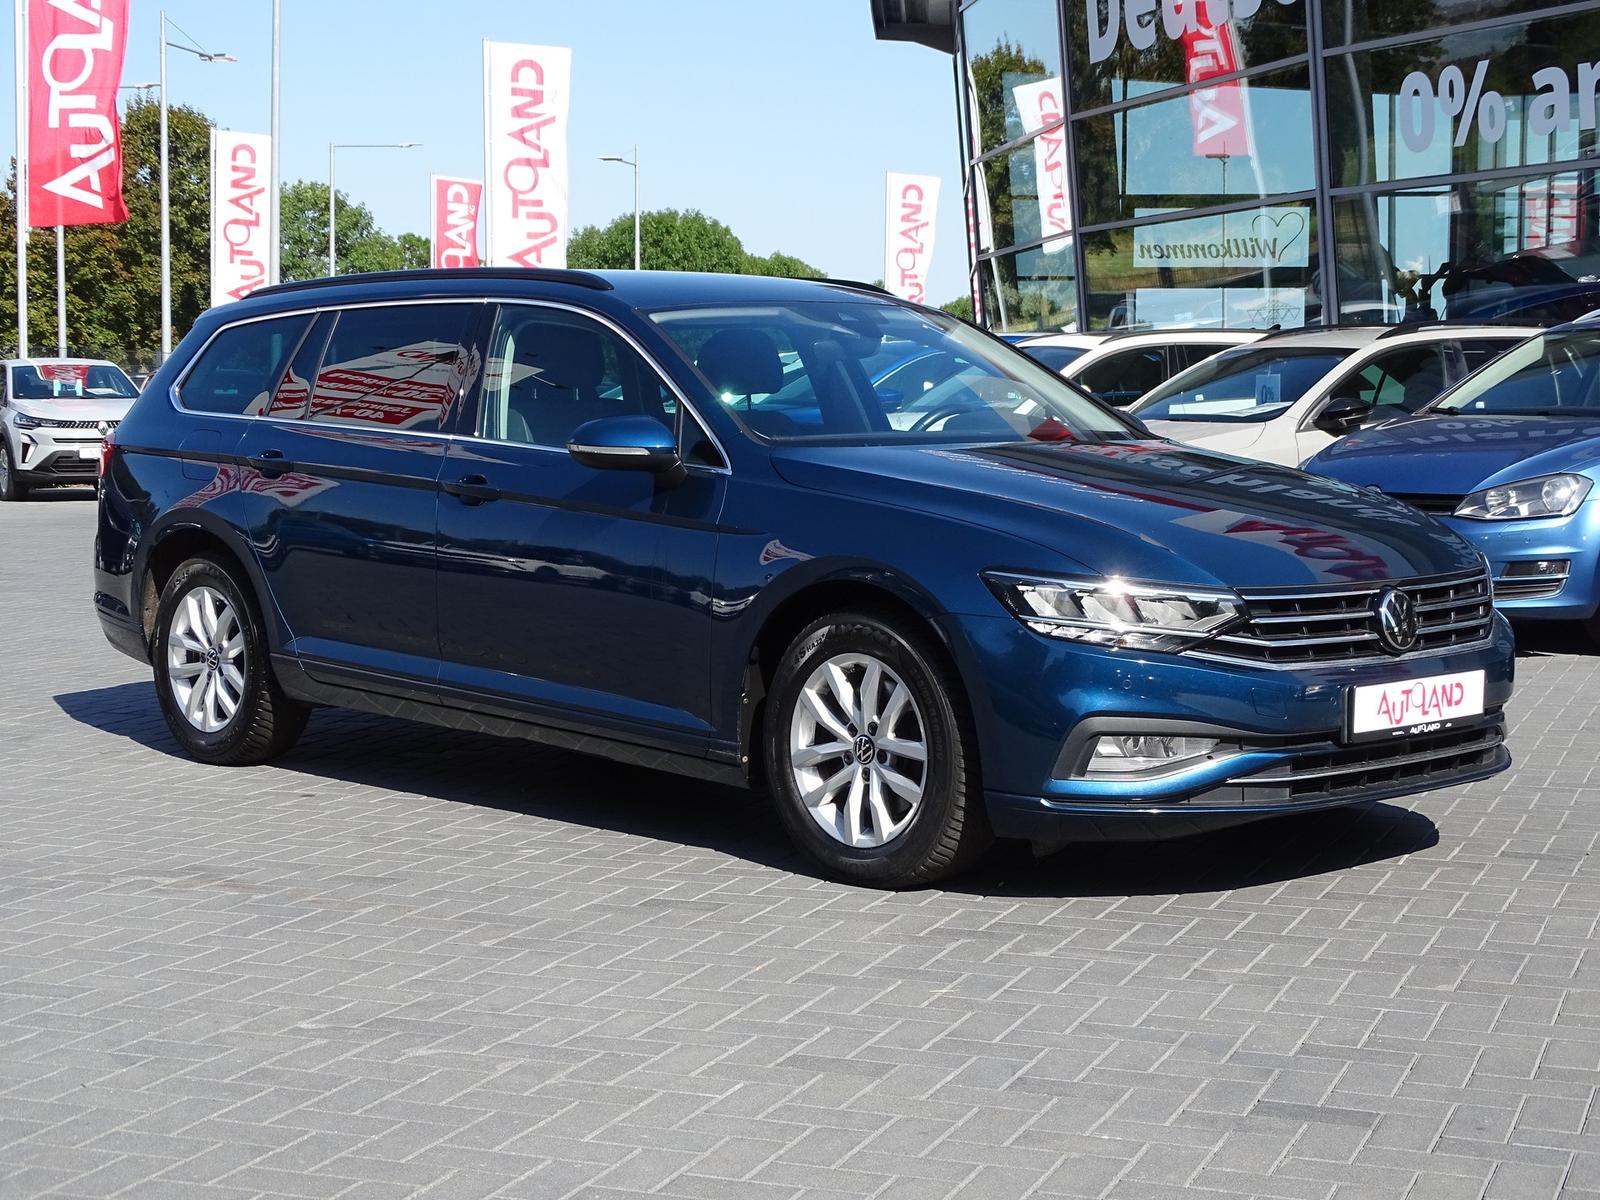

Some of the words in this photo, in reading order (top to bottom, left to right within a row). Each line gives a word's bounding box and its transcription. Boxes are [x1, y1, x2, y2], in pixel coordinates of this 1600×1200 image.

[1400, 59, 1506, 153] 0%
[1377, 681, 1464, 725] AUTOLAND
[1410, 722, 1441, 734] AUTOLAND
